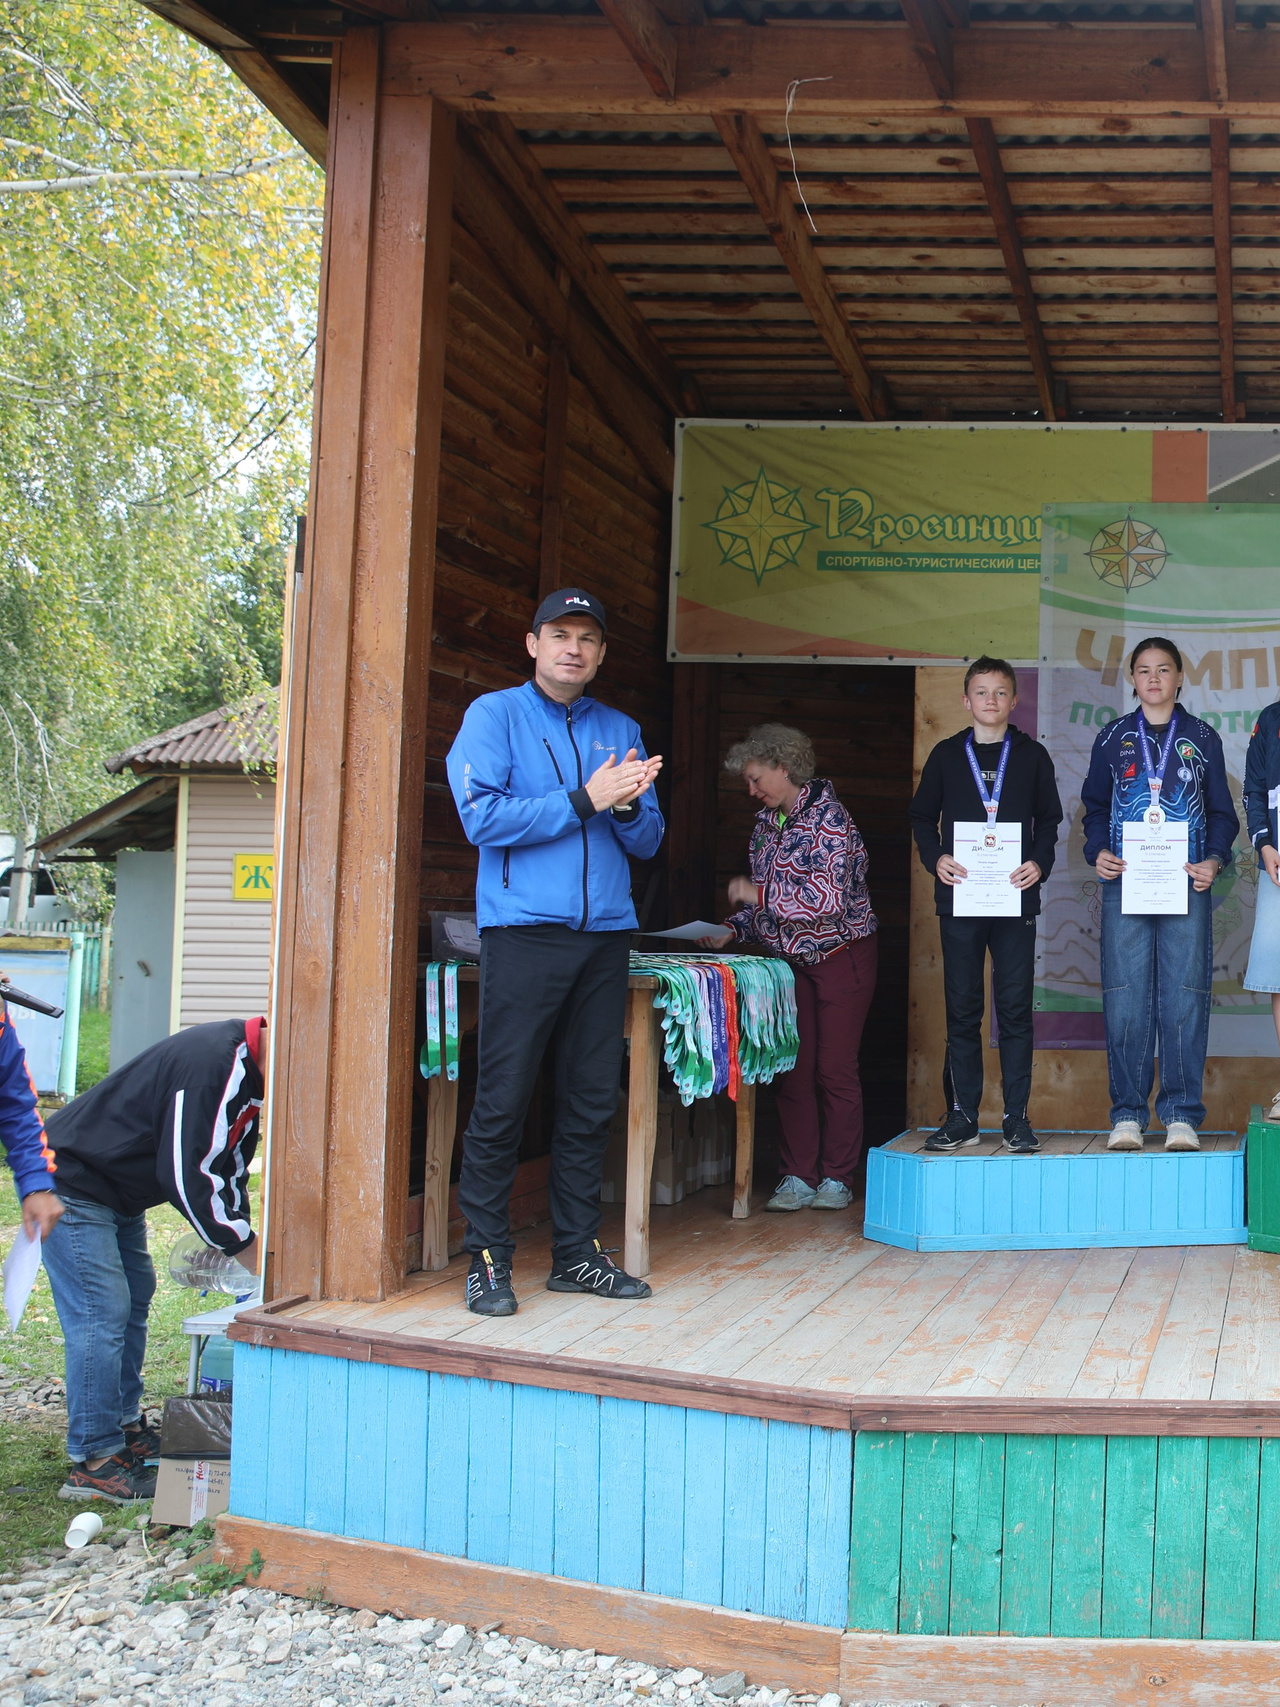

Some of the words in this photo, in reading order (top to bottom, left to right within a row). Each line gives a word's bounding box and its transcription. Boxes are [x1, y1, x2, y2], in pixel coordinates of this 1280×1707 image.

[825, 555, 1014, 569] СПОРТИВНО-ТУРИСТИЧЕСКИЙ
[565, 596, 590, 607] FILA
[1069, 701, 1118, 729] по
[1120, 749, 1136, 757] DINA
[241, 865, 273, 889] Ж
